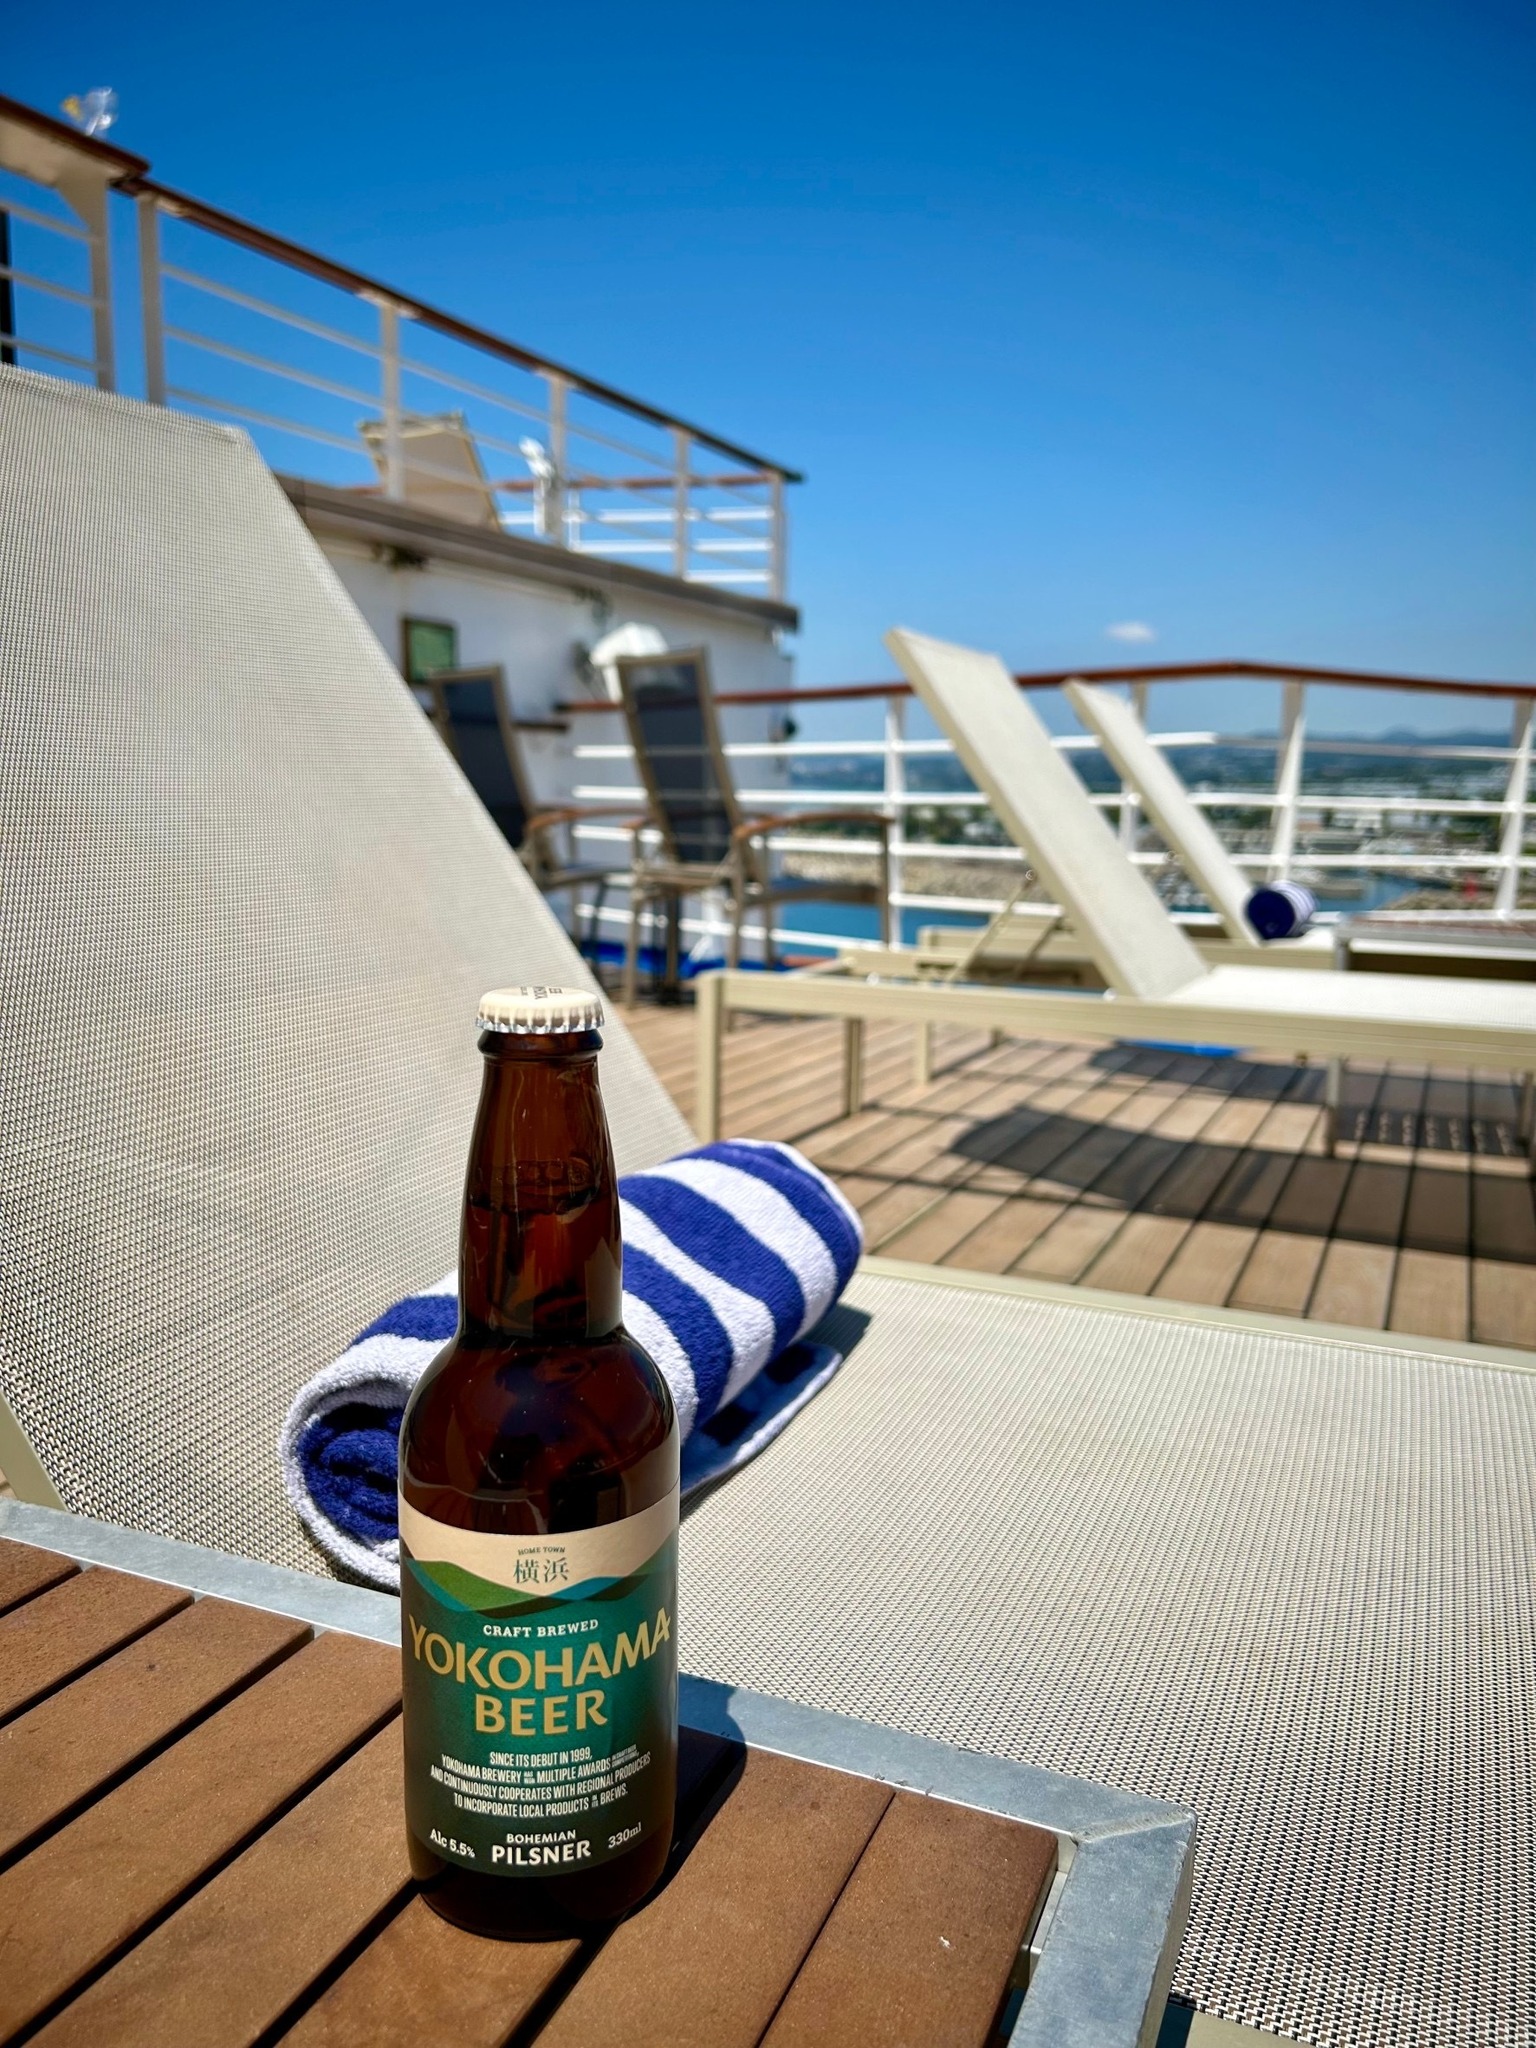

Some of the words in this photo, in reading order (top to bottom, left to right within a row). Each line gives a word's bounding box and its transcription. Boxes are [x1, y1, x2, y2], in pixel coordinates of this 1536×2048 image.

[518, 1547, 541, 1556] HOME
[513, 1557, 569, 1584] 横浜
[483, 1623, 532, 1638] CRAFT
[537, 1619, 599, 1638] BREWED
[408, 1607, 671, 1691] YOKOHAMA
[475, 1689, 608, 1736] BEER
[441, 1753, 481, 1779] YOKOHAMA
[482, 1766, 522, 1784] BREWERY
[537, 1767, 576, 1784] MULTIPLE
[577, 1757, 611, 1778] AWARDS
[490, 1751, 514, 1767] SINCE
[515, 1753, 529, 1767] ITS
[531, 1752, 558, 1767] DEBUT
[559, 1750, 569, 1764] IN
[571, 1746, 593, 1761] 1999,
[430, 1764, 443, 1782] AND
[443, 1771, 498, 1798] CONTINUOUSLY
[499, 1786, 552, 1801] COOPERATES
[553, 1782, 576, 1799] WITH
[577, 1772, 614, 1795] REGIONAL
[615, 1751, 651, 1783] PRODUCERS
[454, 1792, 463, 1808] TO
[463, 1796, 518, 1817] INCORPORATE
[519, 1804, 544, 1818] LOCAL
[545, 1796, 590, 1816] PRODUCTS
[430, 1828, 448, 1848] Alc
[449, 1838, 476, 1859] 5.5%
[506, 1829, 577, 1844] BOHEMIAN
[608, 1822, 642, 1849] 330ml
[491, 1839, 592, 1866] PILSNER
